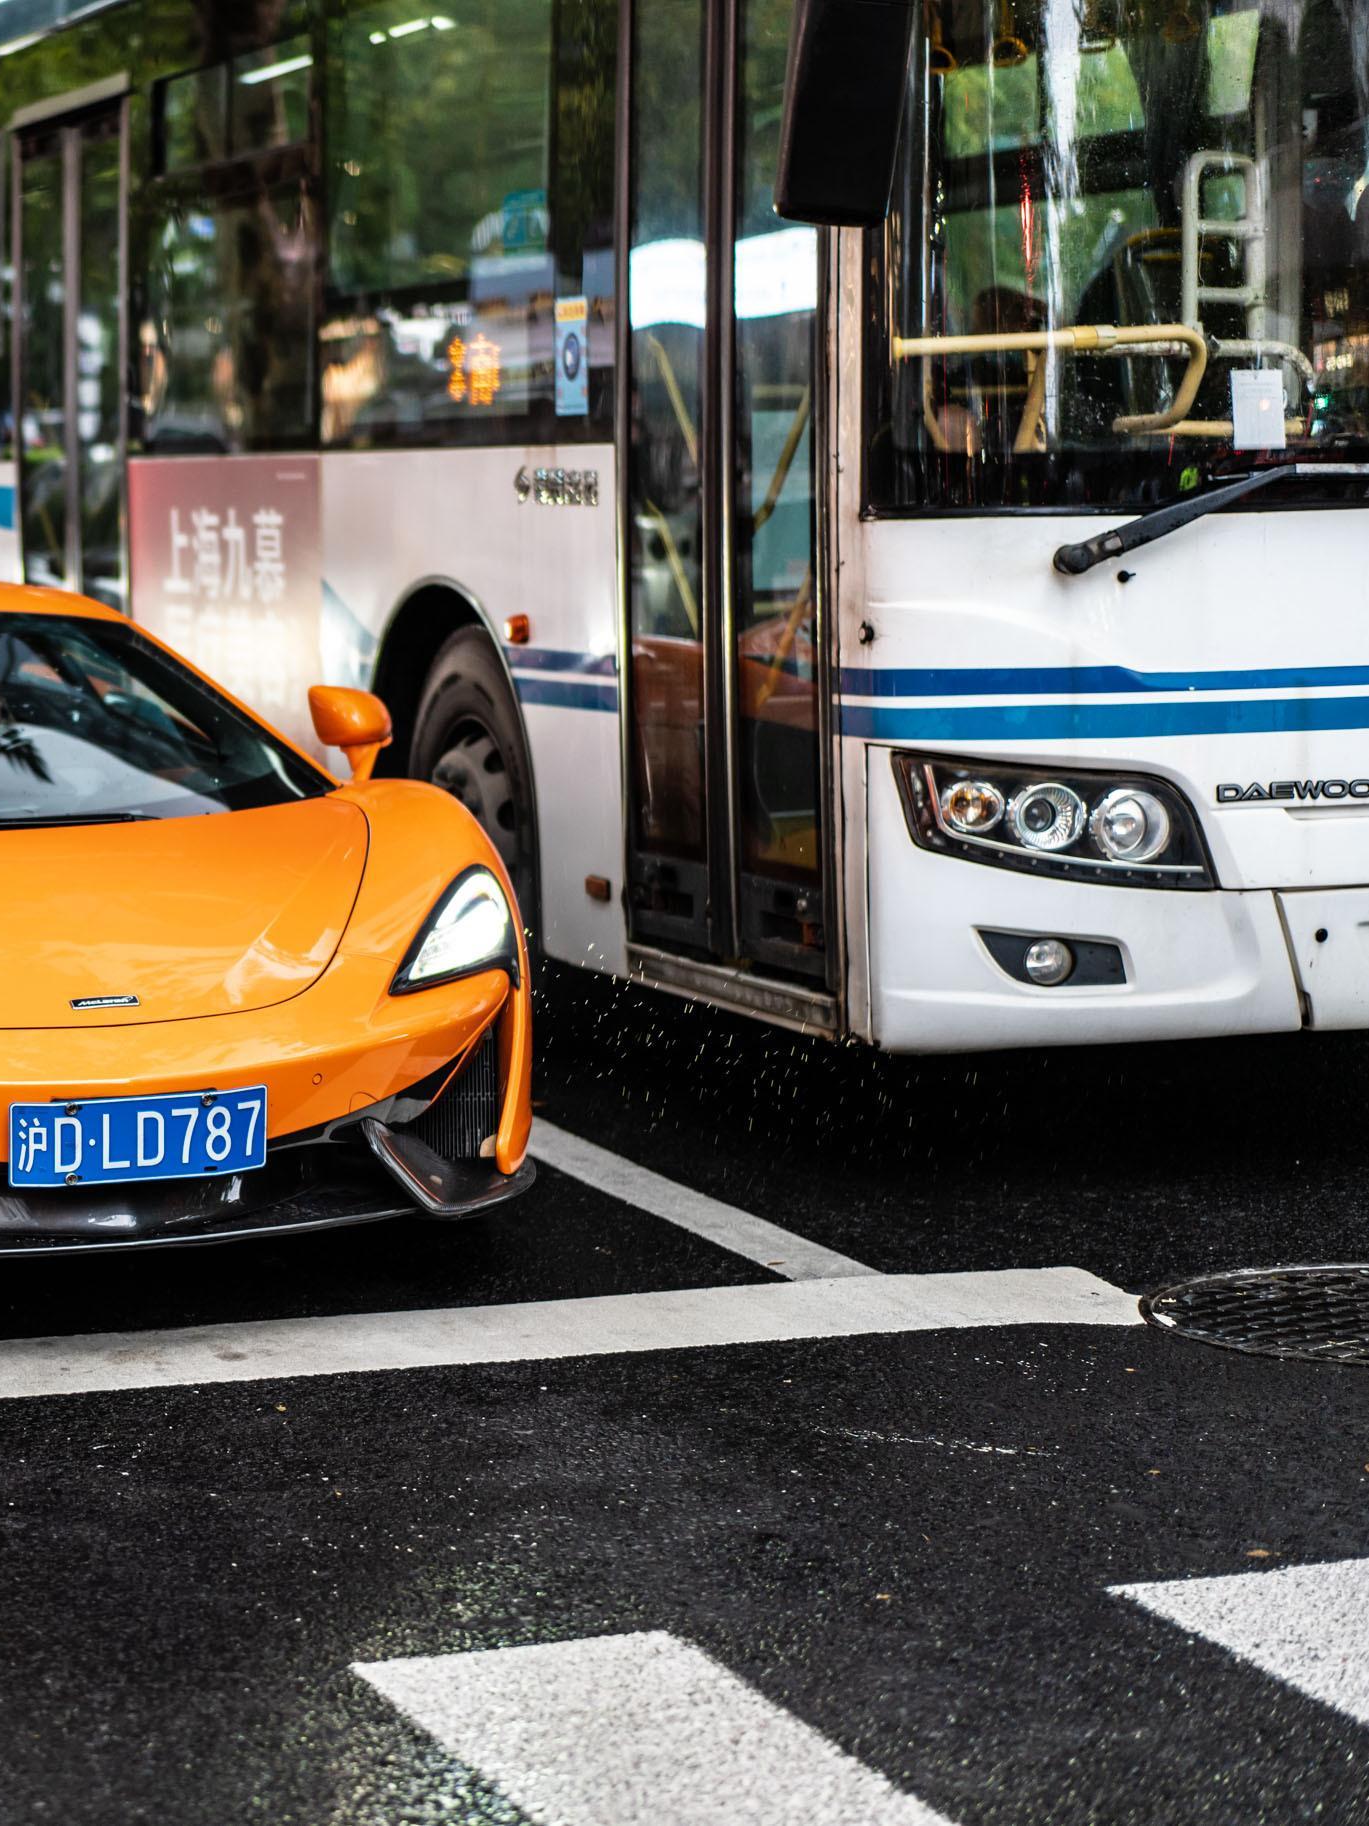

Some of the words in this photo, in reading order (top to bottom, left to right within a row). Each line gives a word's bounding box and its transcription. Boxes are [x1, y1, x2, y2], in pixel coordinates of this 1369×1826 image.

[1217, 779, 1369, 802] DAEWOO
[78, 996, 133, 1006] McLaren
[18, 1100, 262, 1173] 沪D·LD787
